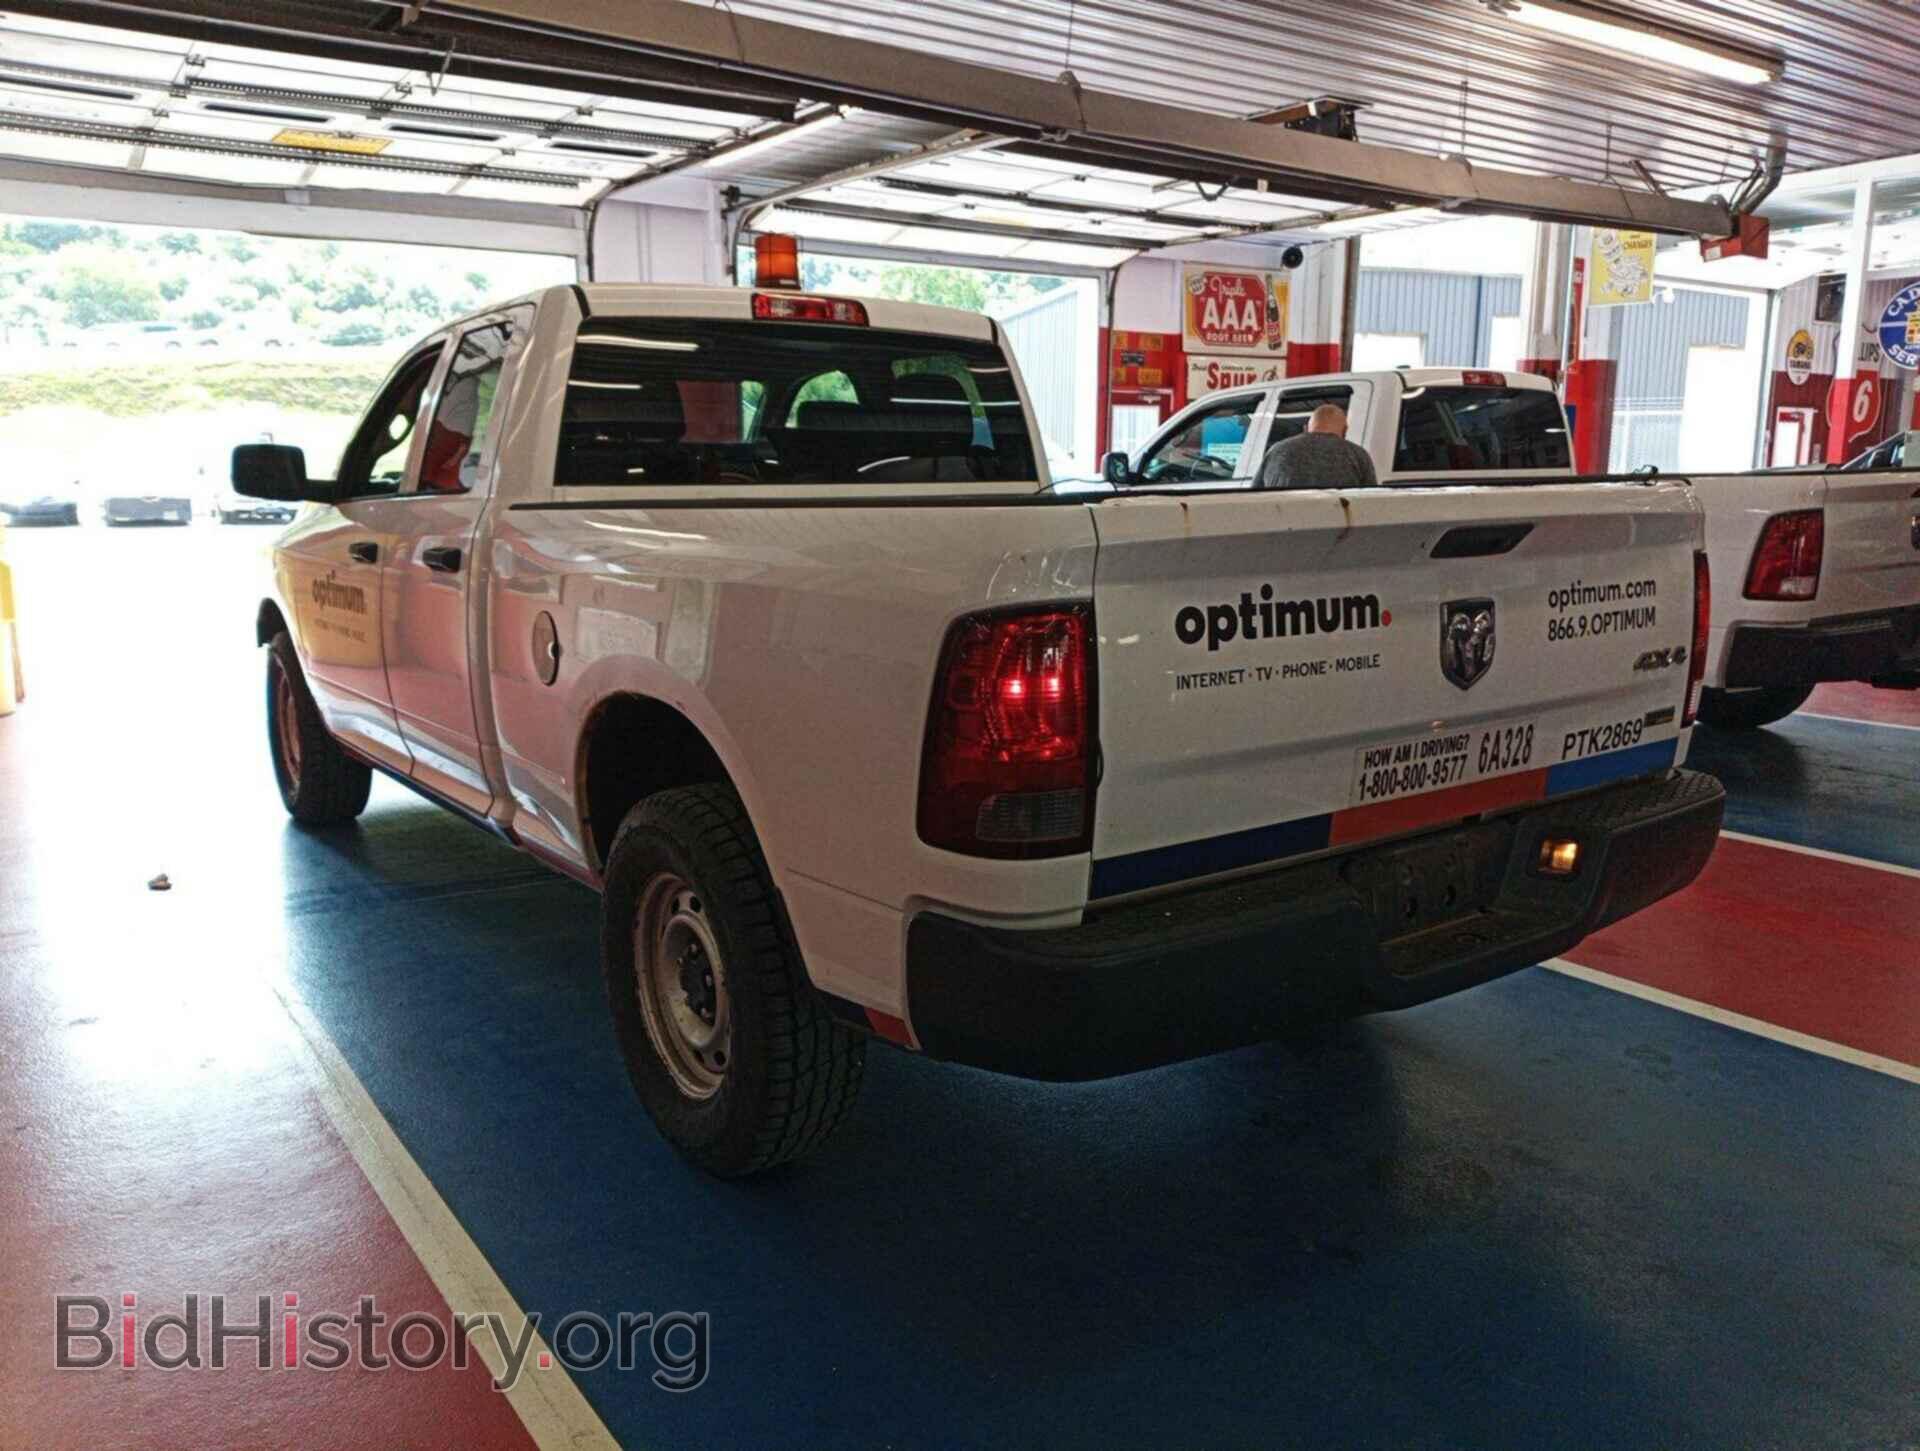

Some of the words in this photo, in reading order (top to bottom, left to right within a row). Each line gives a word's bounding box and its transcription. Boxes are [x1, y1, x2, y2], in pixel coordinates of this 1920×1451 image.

[1201, 297, 1259, 331] AAA
[1853, 380, 1873, 423] 6
[1548, 580, 1656, 613] optimum.com
[1548, 606, 1656, 641] 866.9.OPTIMUM
[1176, 668, 1245, 690] INTERNET
[1256, 666, 1273, 681] TV
[1282, 660, 1327, 679] PHONE
[1335, 654, 1380, 673] MOBILE
[1364, 748, 1391, 770] HOW
[1394, 744, 1412, 763] AM
[1420, 733, 1471, 758] DRIVING?
[1478, 724, 1535, 774] 6A328
[1562, 718, 1643, 761] PTK2869
[1359, 753, 1468, 801] 1-800-800-9577
